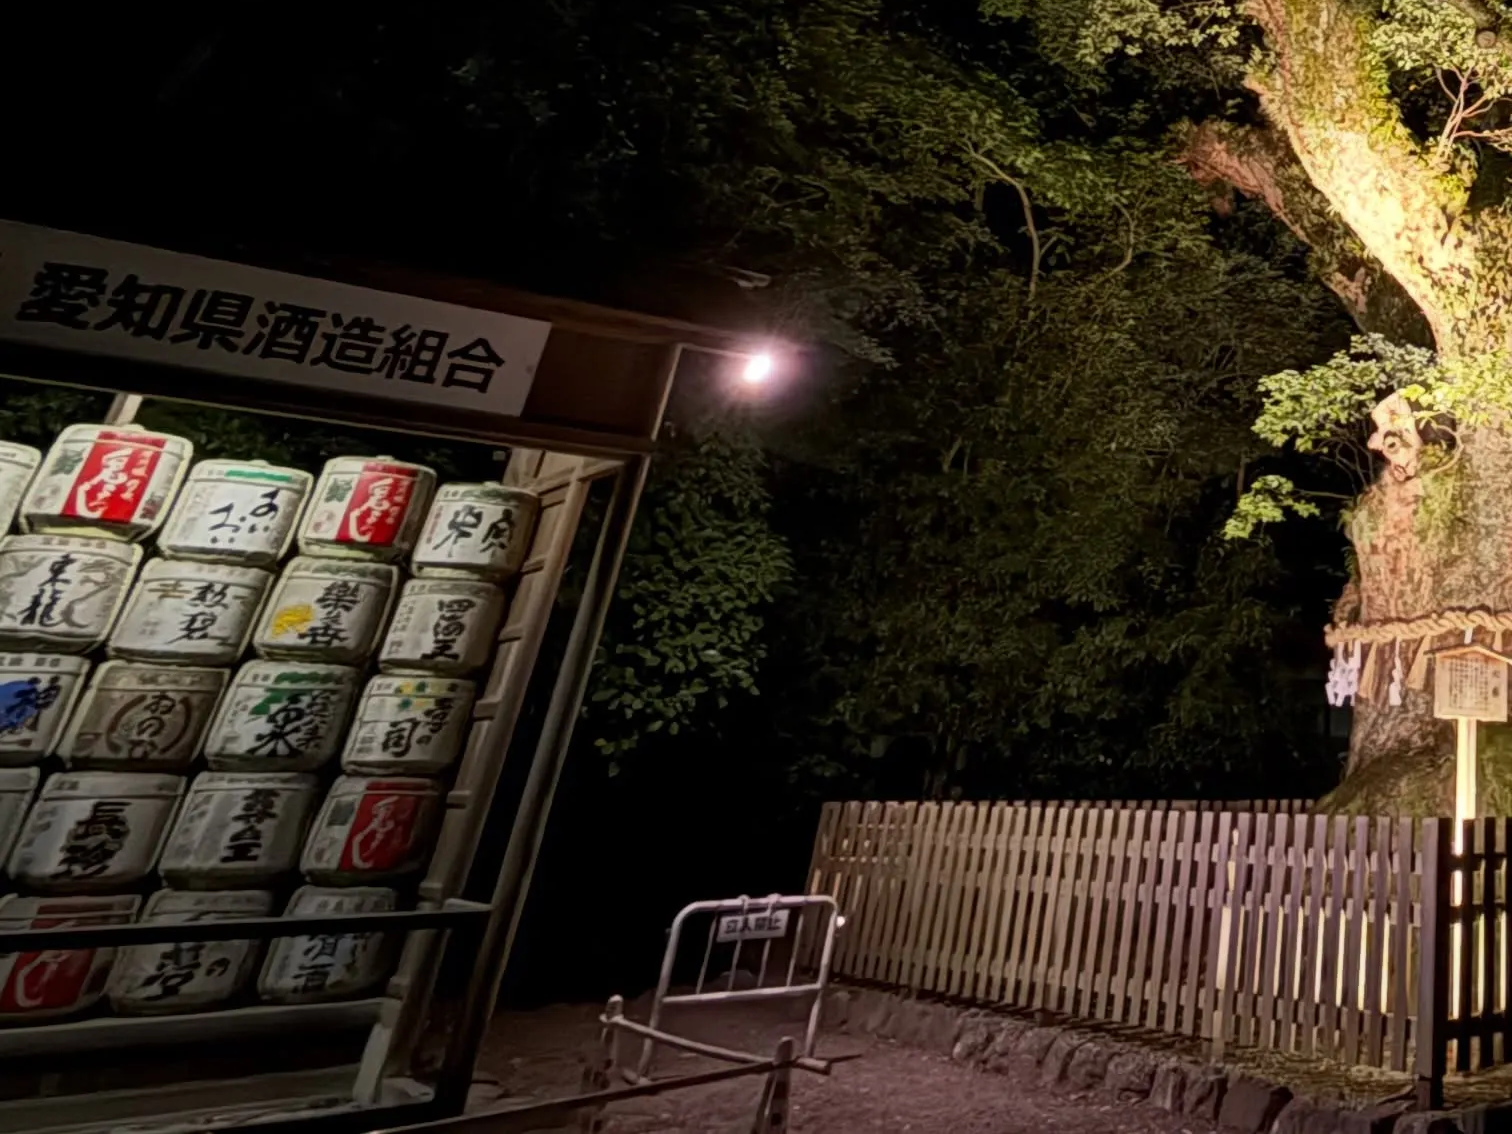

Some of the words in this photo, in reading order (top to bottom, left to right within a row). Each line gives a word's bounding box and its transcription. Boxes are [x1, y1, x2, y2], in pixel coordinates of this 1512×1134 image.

[15, 262, 507, 394] 愛知県酒造組合
